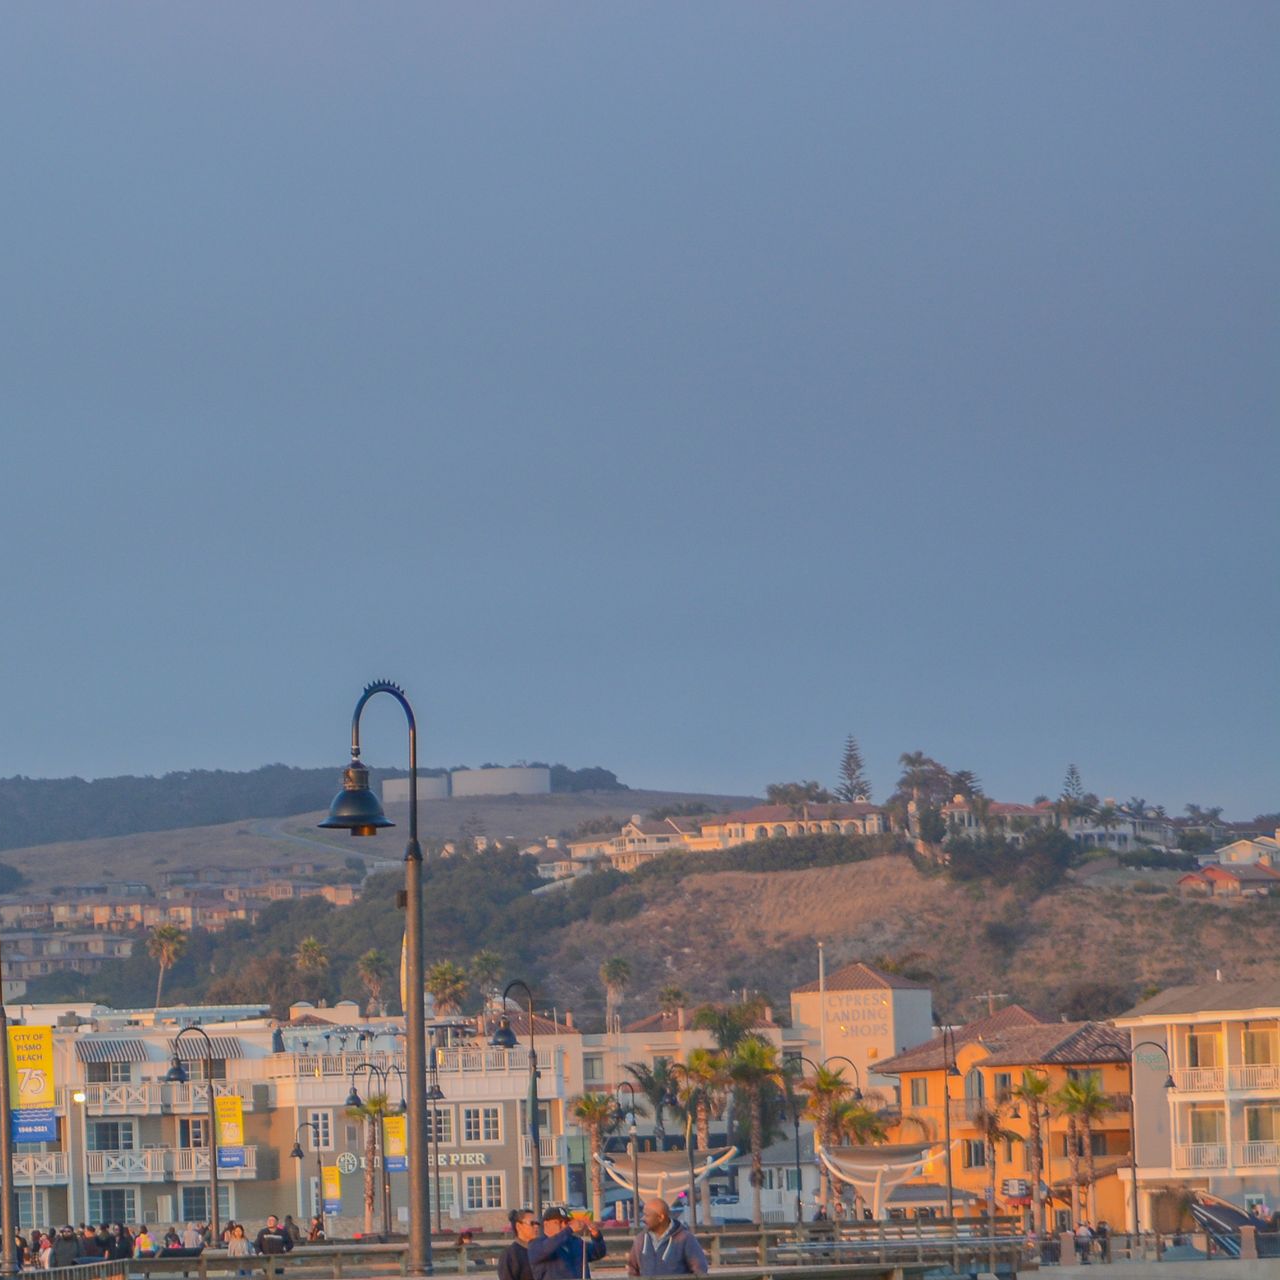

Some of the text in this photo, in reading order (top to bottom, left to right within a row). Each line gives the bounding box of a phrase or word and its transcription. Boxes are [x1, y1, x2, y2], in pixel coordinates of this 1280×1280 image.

[828, 992, 888, 1008] CYPRESS
[825, 1008, 887, 1023] LANDING
[841, 1024, 888, 1038] SHOPS
[13, 1034, 30, 1042] CITY
[16, 1054, 42, 1062] BEACH
[450, 1153, 486, 1166] PIER
